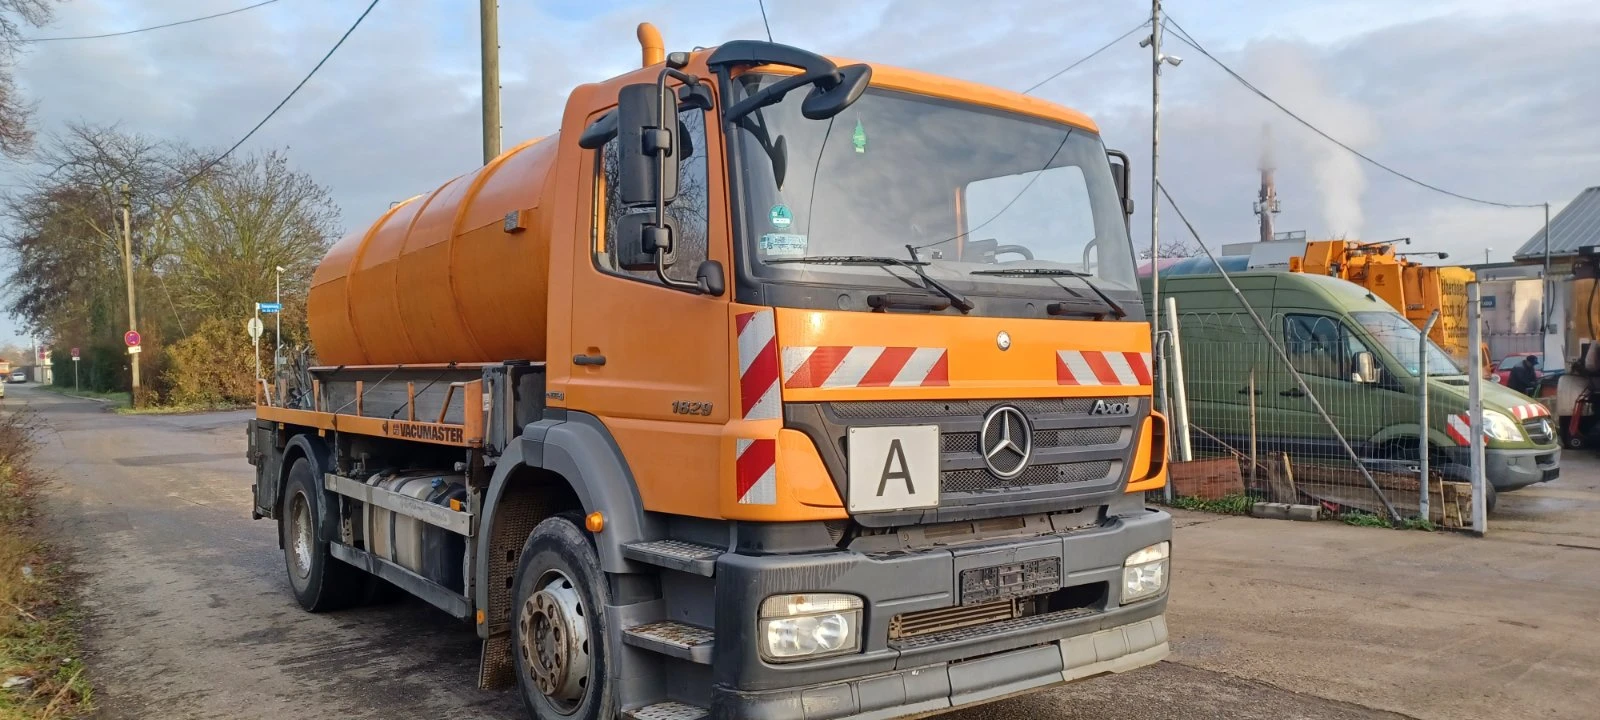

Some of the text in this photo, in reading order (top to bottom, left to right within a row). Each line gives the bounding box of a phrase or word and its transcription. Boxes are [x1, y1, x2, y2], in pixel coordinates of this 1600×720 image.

[672, 401, 713, 416] 1829
[400, 423, 464, 443] VACUMASTER
[876, 438, 916, 497] A
